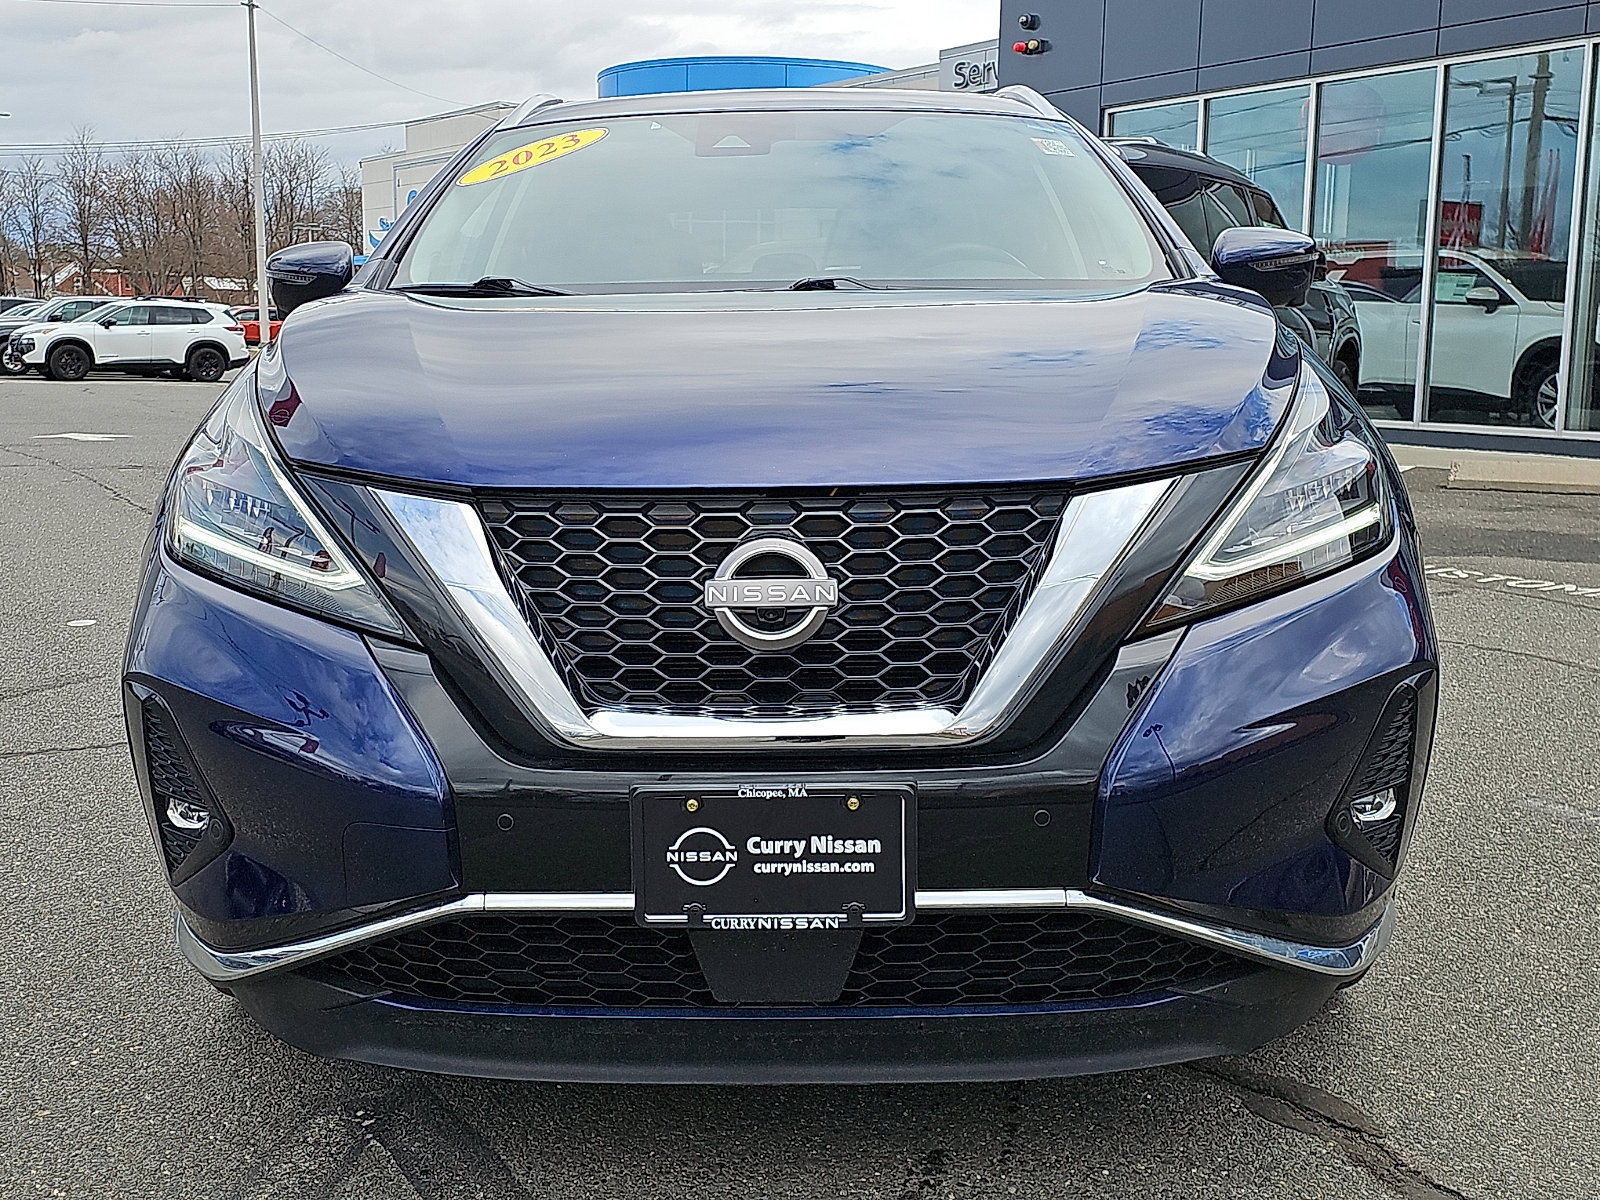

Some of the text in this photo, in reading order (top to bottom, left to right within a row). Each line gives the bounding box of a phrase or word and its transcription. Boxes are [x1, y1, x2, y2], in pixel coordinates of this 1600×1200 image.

[488, 134, 581, 177] 2023
[708, 585, 835, 602] NISSAN
[737, 788, 808, 799] Chicopee, MA
[746, 836, 882, 858] Curry Nissan
[666, 851, 738, 862] NISSAN
[753, 860, 875, 876] currynissan.com
